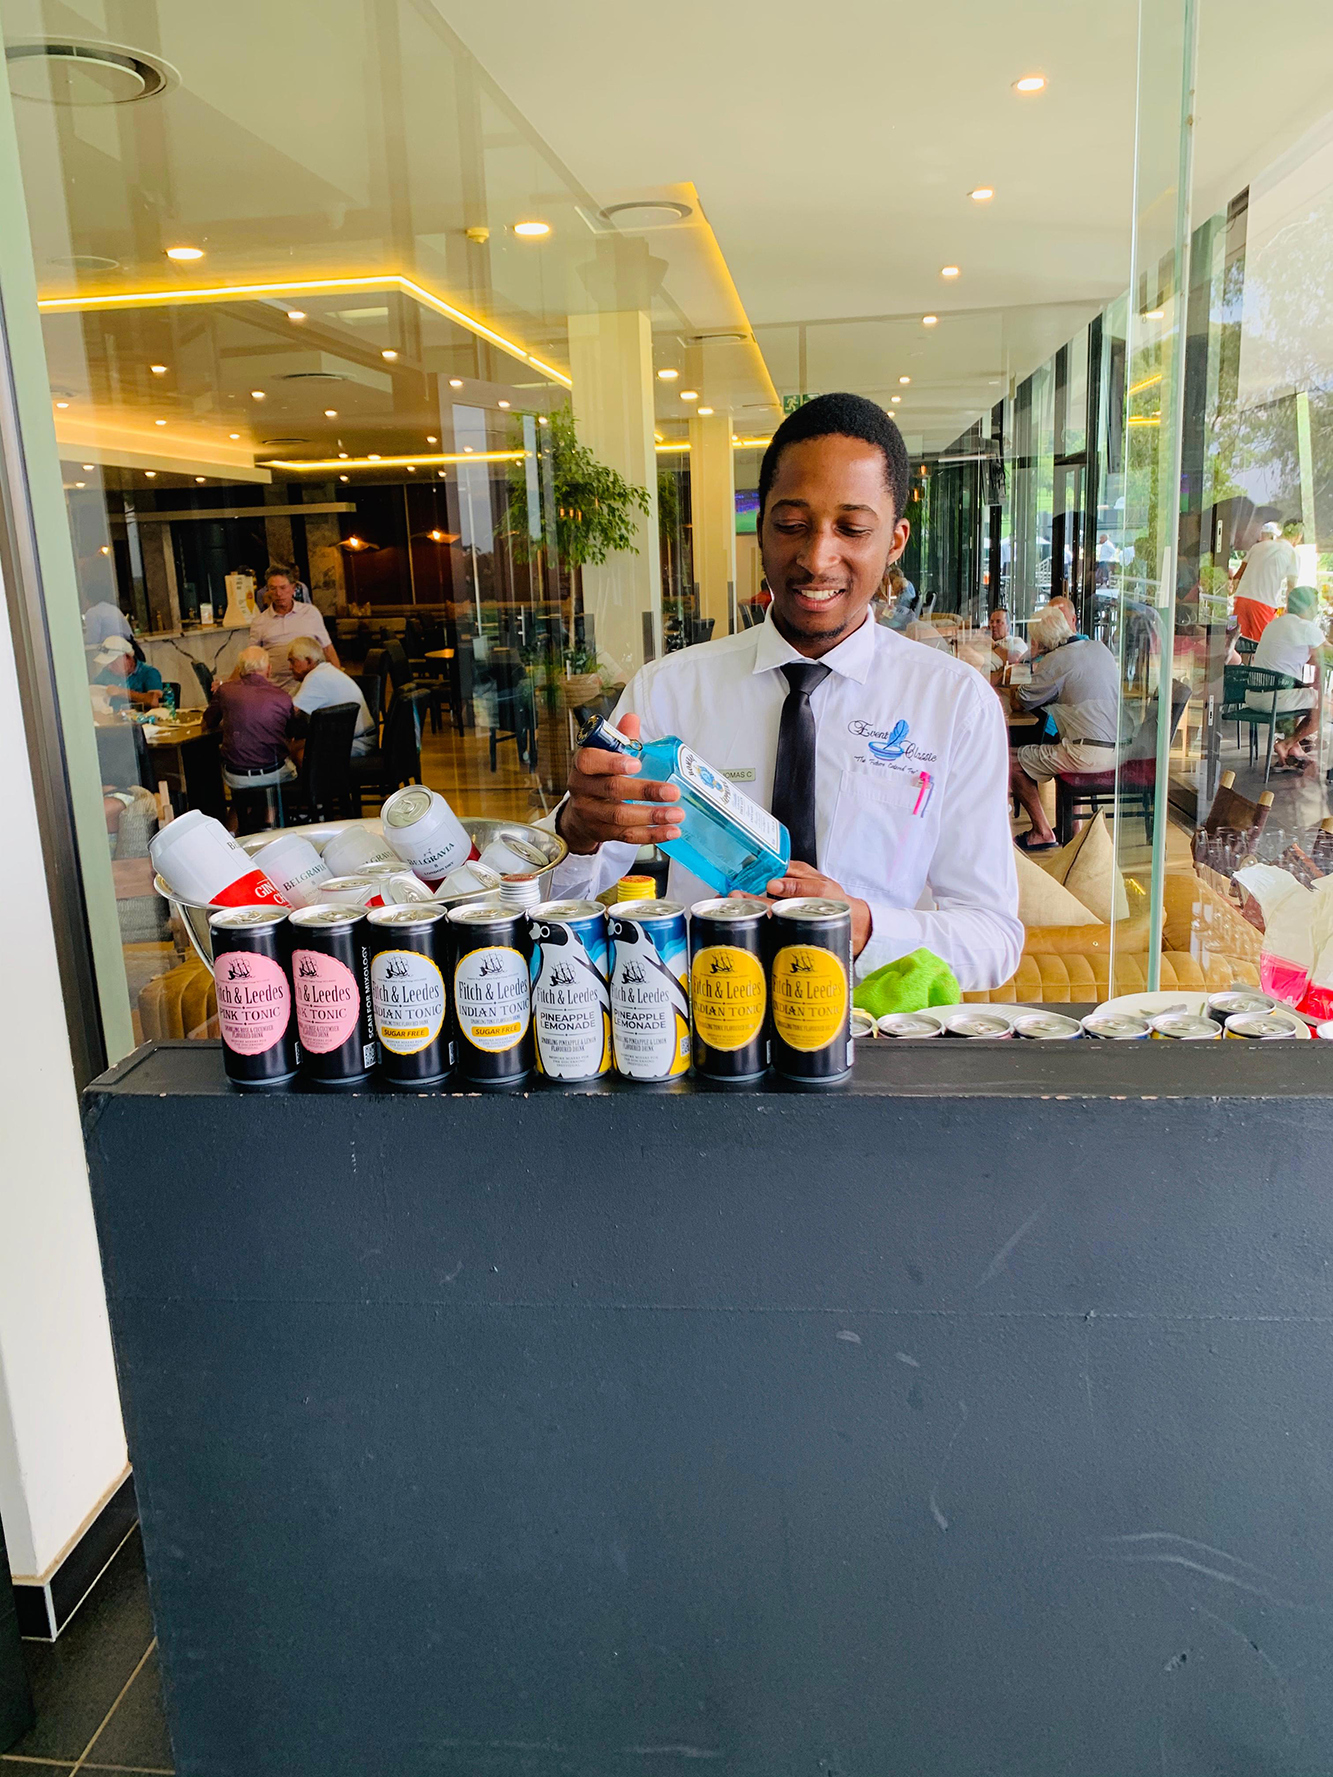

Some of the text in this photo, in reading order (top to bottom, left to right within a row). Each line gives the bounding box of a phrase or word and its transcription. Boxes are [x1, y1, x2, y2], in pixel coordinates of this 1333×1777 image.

[848, 720, 889, 740] Event
[407, 842, 455, 867] BELGRAVIA
[254, 881, 276, 898] GIN
[361, 946, 371, 994] MIXOLOGY
[235, 987, 242, 1004] &
[245, 984, 284, 1004] Leedes
[304, 985, 310, 1002] &
[312, 985, 351, 1003] Leedes
[391, 986, 399, 1003] &
[402, 984, 440, 1003] Leedes
[458, 978, 528, 1001] Fitch & Leedes
[537, 986, 598, 1005] Fitch & Leedes
[628, 987, 635, 1004] &
[637, 988, 670, 1004] Leedes
[715, 981, 723, 999] &
[726, 980, 761, 999] Leedes
[794, 981, 803, 999] &
[807, 980, 841, 999] Leedes
[241, 1007, 280, 1021] TONIC
[310, 1008, 347, 1020] TONIC
[405, 1004, 442, 1019] TONIC
[459, 1004, 497, 1017] INDIAN
[540, 1011, 595, 1022] PINEAPPLE
[614, 1008, 665, 1021] PINEAPPLE
[728, 1003, 762, 1017] TONIC
[367, 1014, 375, 1039] SCAN
[475, 1025, 518, 1035] SUGAR FREE
[540, 1020, 596, 1031] LEMONADE
[614, 1017, 666, 1030] LEMONADE
[384, 1029, 425, 1037] SUGAR FREE
